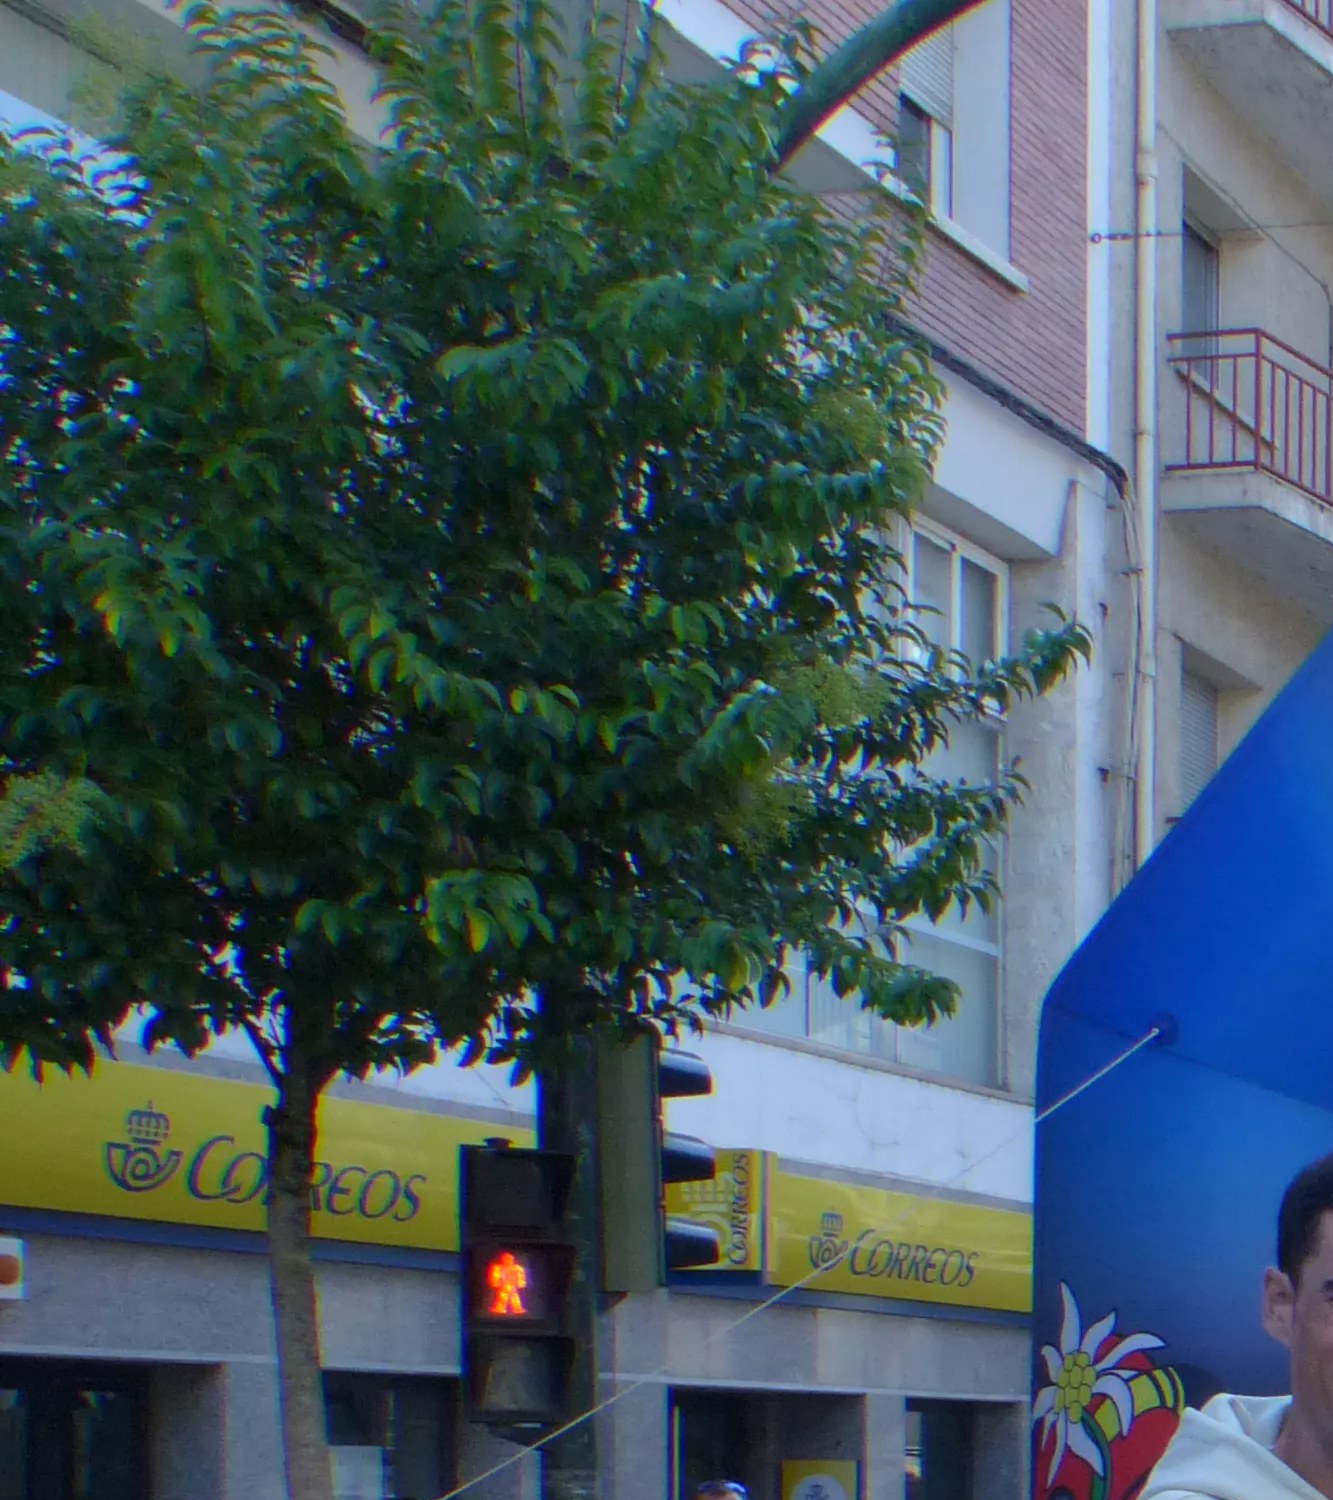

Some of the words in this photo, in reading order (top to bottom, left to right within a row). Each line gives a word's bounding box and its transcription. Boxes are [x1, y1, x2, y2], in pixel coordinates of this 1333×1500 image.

[187, 1134, 427, 1222] COREOS
[725, 1152, 750, 1266] CORREOS
[849, 1228, 980, 1288] CORREOS
